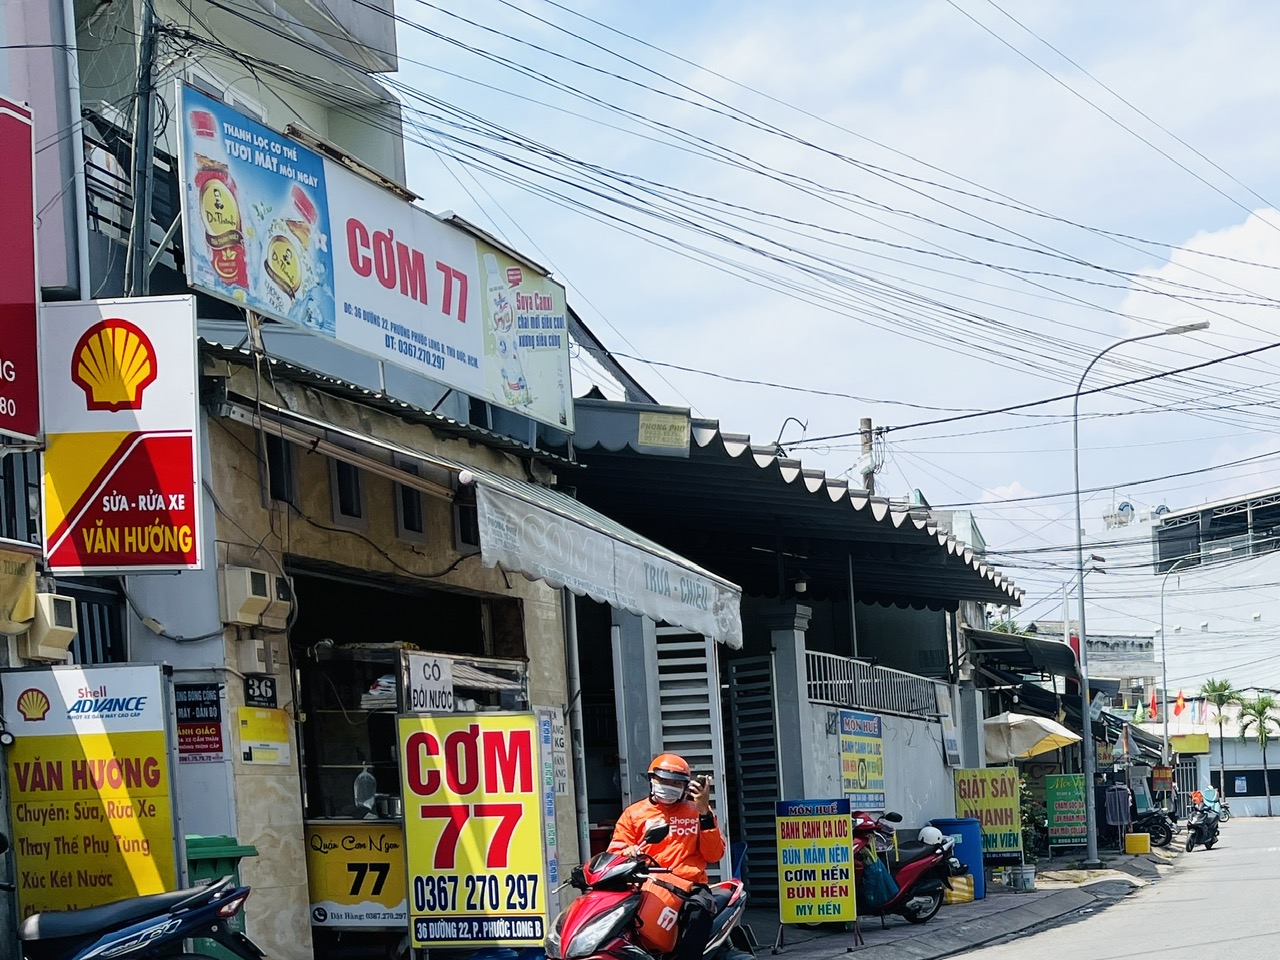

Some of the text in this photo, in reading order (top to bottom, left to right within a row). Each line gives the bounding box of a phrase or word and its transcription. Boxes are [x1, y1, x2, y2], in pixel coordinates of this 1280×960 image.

[223, 122, 252, 144] THANH
[253, 134, 269, 151] LỌC
[270, 142, 282, 155] CƠ
[254, 151, 278, 173] MÁT
[297, 170, 318, 188] NGÀY
[346, 217, 468, 324] CƠM 77
[102, 488, 186, 512] SỬA RỬA XE
[82, 517, 193, 554] VĂN HƯỚNG
[643, 562, 672, 599] TRƯA
[423, 659, 441, 682] CÓ
[78, 686, 107, 699] Shell
[248, 678, 273, 698] 36
[67, 696, 147, 714] ADVANCE
[406, 724, 534, 796] CƠM
[14, 756, 64, 793] VĂN
[958, 770, 1016, 804] GIẶT SẤY
[16, 802, 70, 827] Chuyên:
[138, 798, 157, 818] Xe
[788, 803, 813, 816] MÓN
[815, 801, 838, 815] HUẾ
[420, 803, 523, 870] 77
[669, 824, 699, 836] Food
[801, 819, 822, 840] CANH
[999, 828, 1019, 848] VIÊN
[18, 832, 151, 861] Thay Thế Phụ Tùng
[310, 833, 339, 854] Quán
[341, 834, 367, 851] Cơm
[782, 841, 850, 865] BÚN MẮM NÊM
[21, 868, 113, 890] Xúc Két Nước
[346, 862, 391, 896] 77
[784, 864, 850, 882] CƠM HẾN
[413, 873, 539, 912] 0367 270 297
[786, 881, 849, 899] BÚN HẾN
[818, 900, 841, 915] HẾN
[416, 917, 542, 939] 36 ĐƯỜNG 22, P. PHƯỚC LONG B
